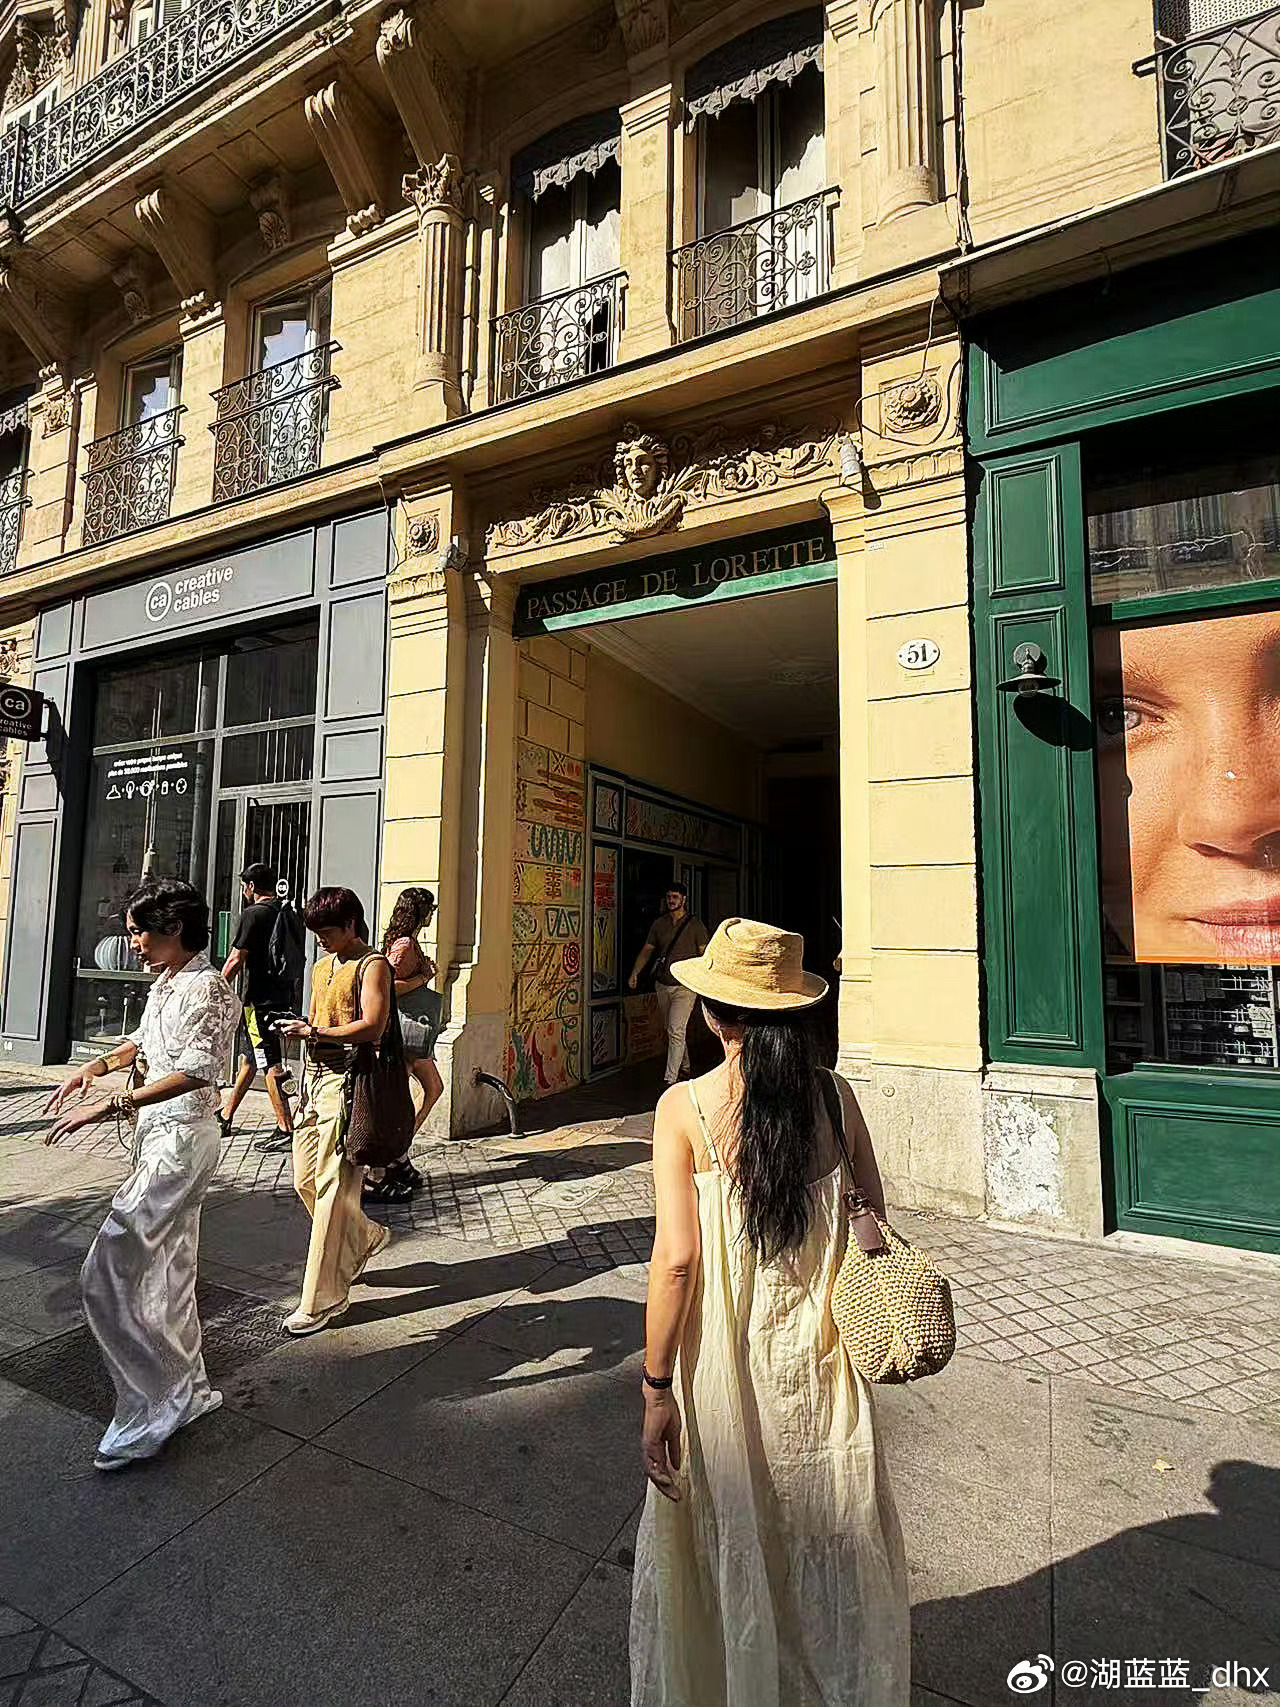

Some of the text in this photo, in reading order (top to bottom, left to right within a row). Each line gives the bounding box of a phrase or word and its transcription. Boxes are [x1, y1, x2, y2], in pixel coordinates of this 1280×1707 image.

[175, 567, 233, 595] creative
[527, 537, 826, 619] PASSAGE DE LORETTE
[150, 593, 168, 610] ca
[173, 589, 220, 613] cables
[908, 643, 927, 663] 51
[4, 698, 25, 711] ca
[0, 719, 32, 730] reative
